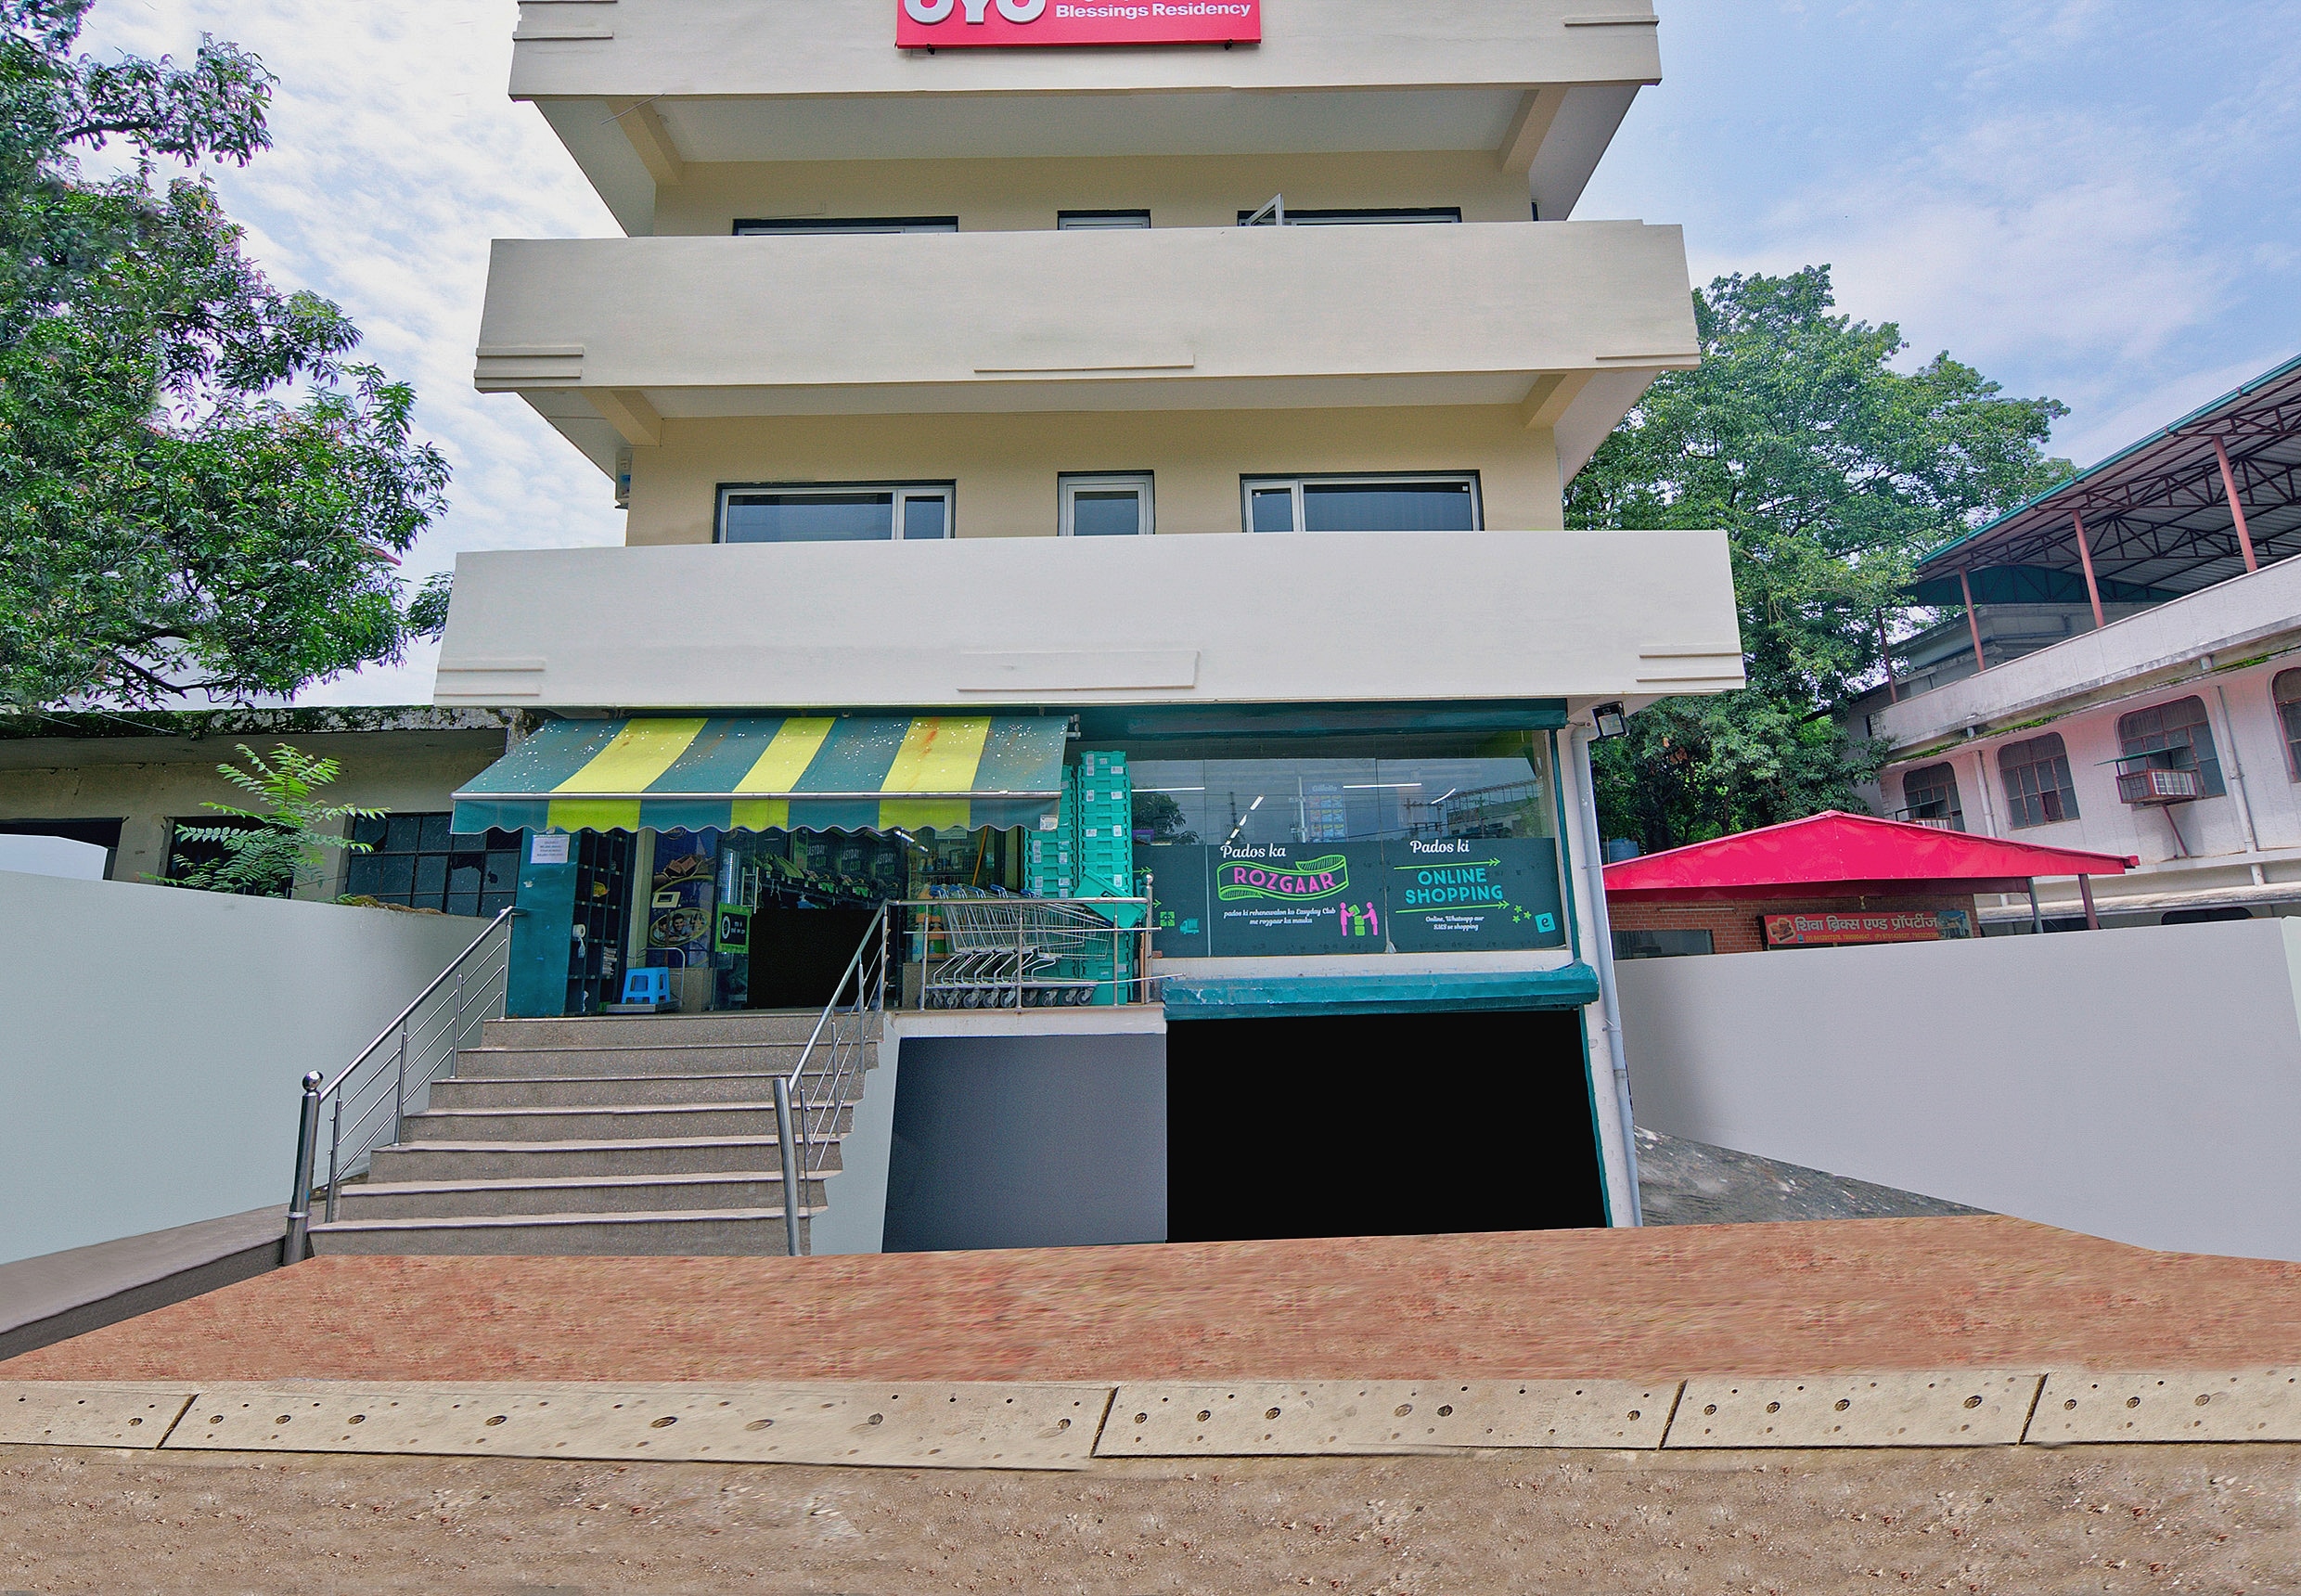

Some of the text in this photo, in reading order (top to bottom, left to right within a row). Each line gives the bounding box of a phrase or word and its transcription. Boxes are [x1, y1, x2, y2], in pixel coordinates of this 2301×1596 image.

[1056, 5, 1150, 19] Blessings
[1151, 3, 1251, 17] Residency
[1220, 843, 1286, 858] Pados ka
[1409, 838, 1470, 854] Pados ki
[1233, 867, 1336, 893] ROZGAAR
[1417, 868, 1487, 885] ONLINE
[1405, 884, 1504, 905] SHOPPING
[1322, 907, 1336, 915] Club
[1454, 923, 1479, 932] shopping
[1794, 916, 1823, 932] शिवा
[1826, 915, 1859, 933] ब्रिक्स
[1862, 919, 1888, 931] एण्ड
